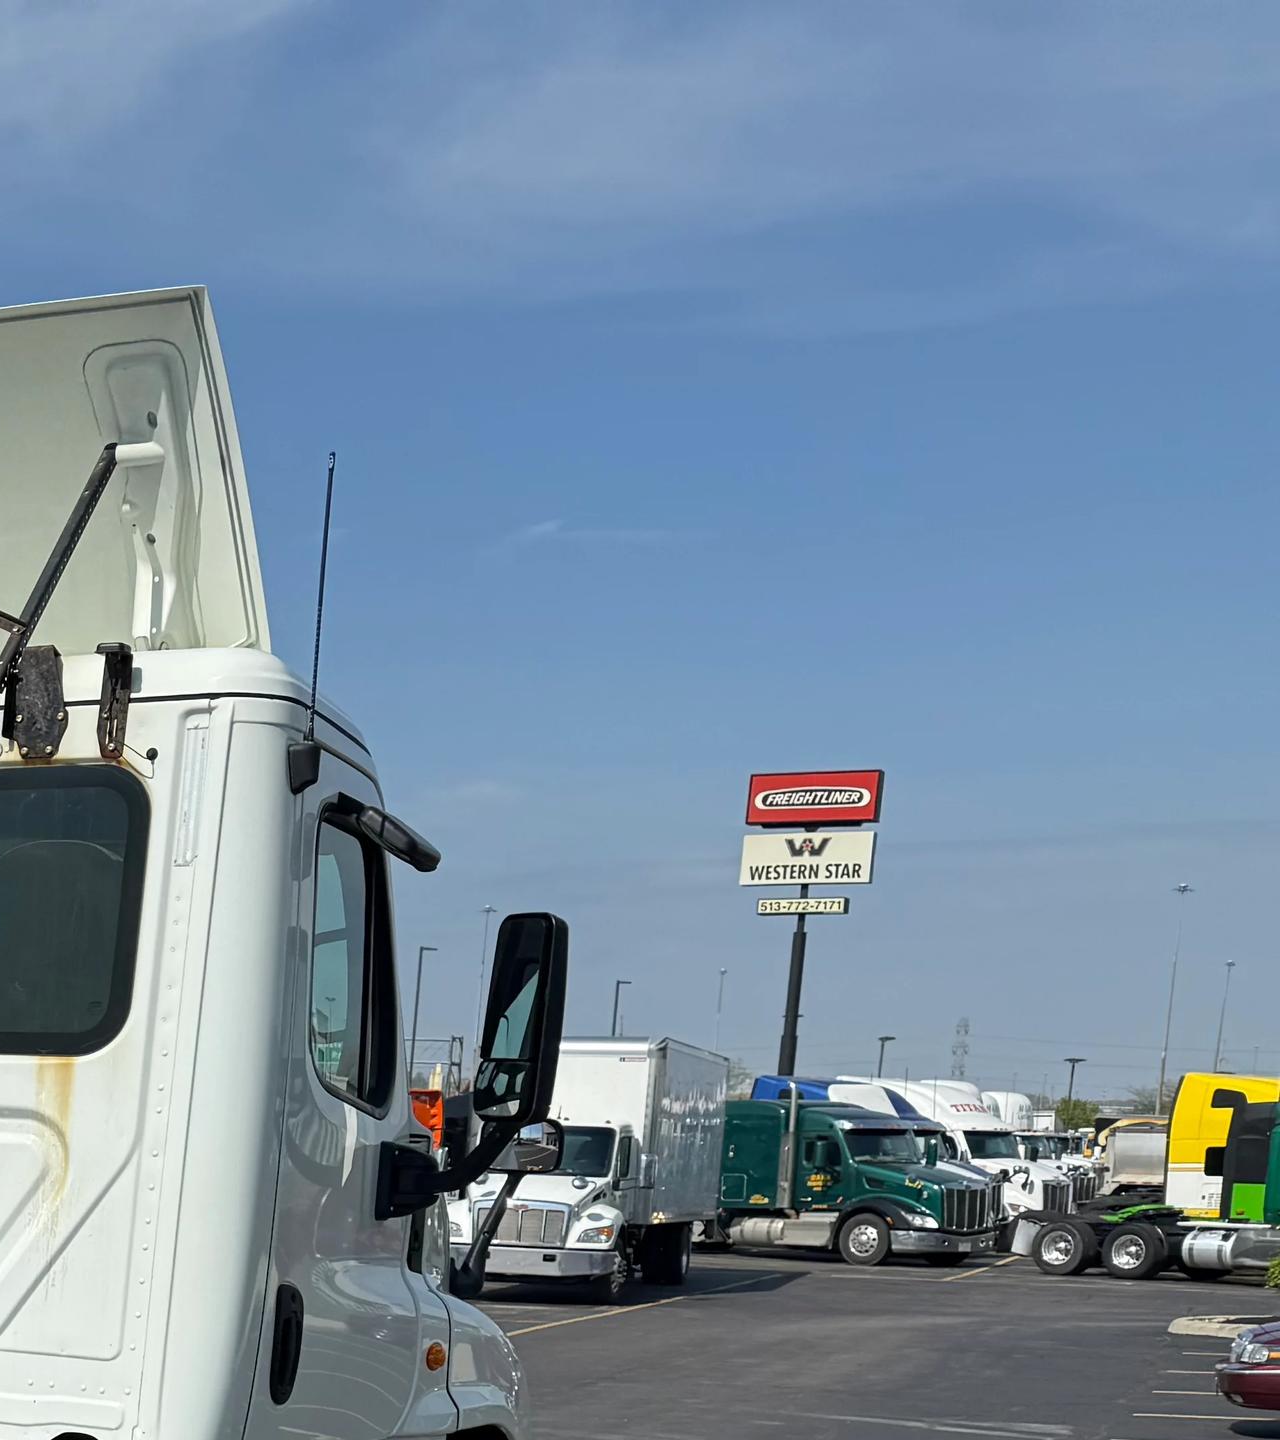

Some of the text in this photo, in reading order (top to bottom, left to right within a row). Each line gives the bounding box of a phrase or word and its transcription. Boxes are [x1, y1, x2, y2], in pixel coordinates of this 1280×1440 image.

[764, 791, 861, 806] FREIGHTLINER
[749, 863, 862, 881] WESTERN STAR
[760, 900, 842, 912] 513-772-7171
